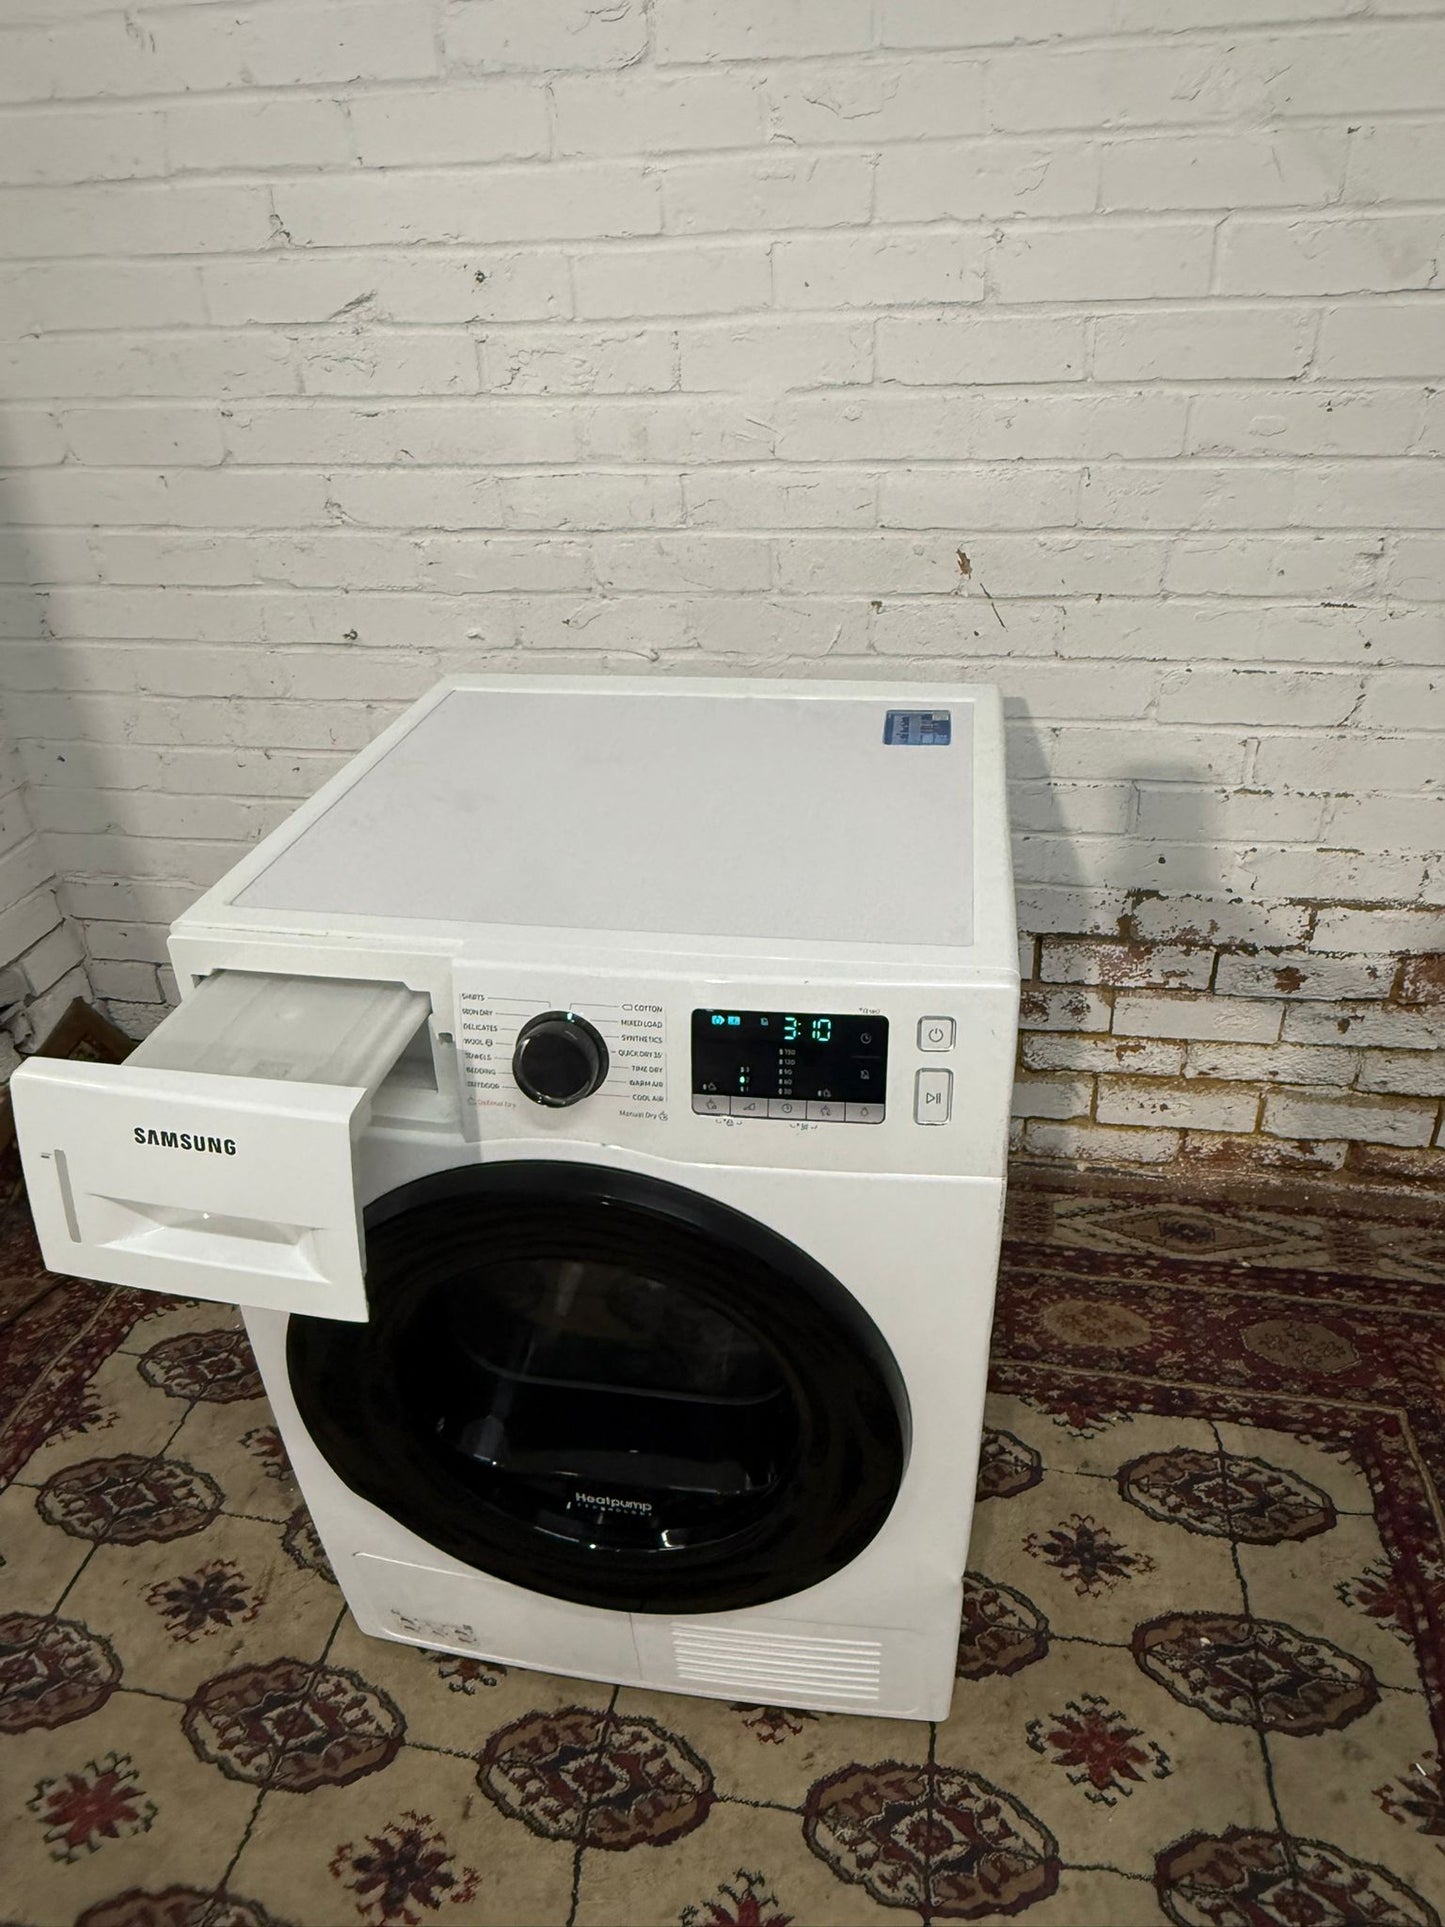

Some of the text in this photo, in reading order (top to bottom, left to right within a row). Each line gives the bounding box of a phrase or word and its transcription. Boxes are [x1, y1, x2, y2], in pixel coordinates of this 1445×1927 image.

[634, 1004, 662, 1013] COTTON
[463, 1022, 498, 1032] DELICATES
[621, 1019, 662, 1029] MIXED LOAD
[784, 1016, 832, 1042] 3:10
[464, 1038, 484, 1046] WOOL
[621, 1034, 663, 1044] SYNTHETICS
[618, 1049, 638, 1057] QUICK
[639, 1050, 652, 1058] DRY
[632, 1065, 647, 1073] TIME
[632, 1094, 650, 1102] COOL
[645, 1110, 657, 1120] Dry
[134, 1127, 236, 1155] SAMSUNG
[575, 1492, 652, 1511] Heatpump
